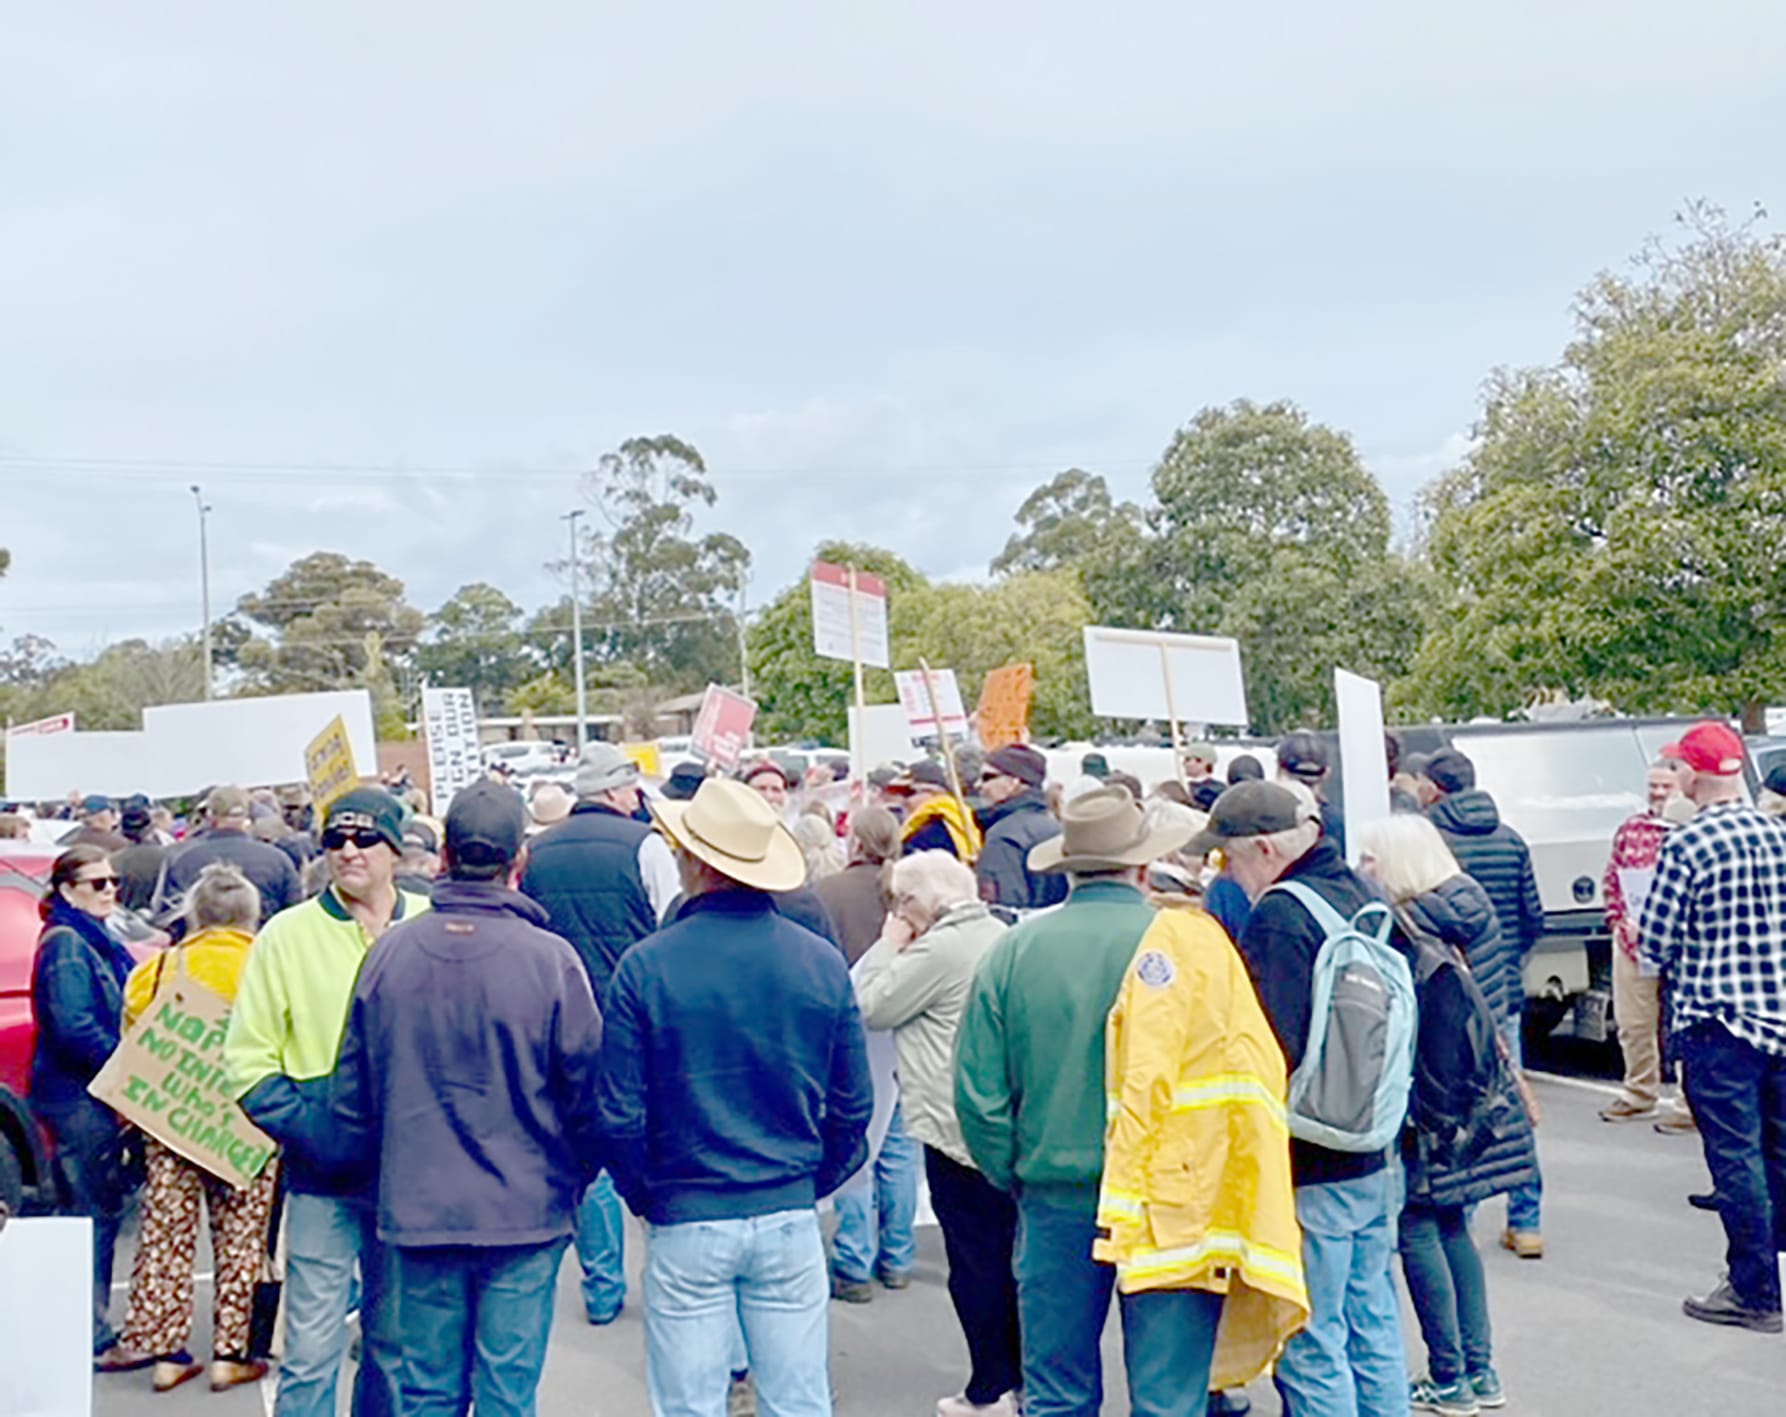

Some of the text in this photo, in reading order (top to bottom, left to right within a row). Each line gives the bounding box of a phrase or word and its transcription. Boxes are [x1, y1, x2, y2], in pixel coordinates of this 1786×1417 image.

[429, 716, 449, 798] PLEASE
[459, 693, 478, 775] TITION
[136, 1026, 179, 1062] NO
[154, 1002, 228, 1056] NOP
[122, 1074, 169, 1112] IN
